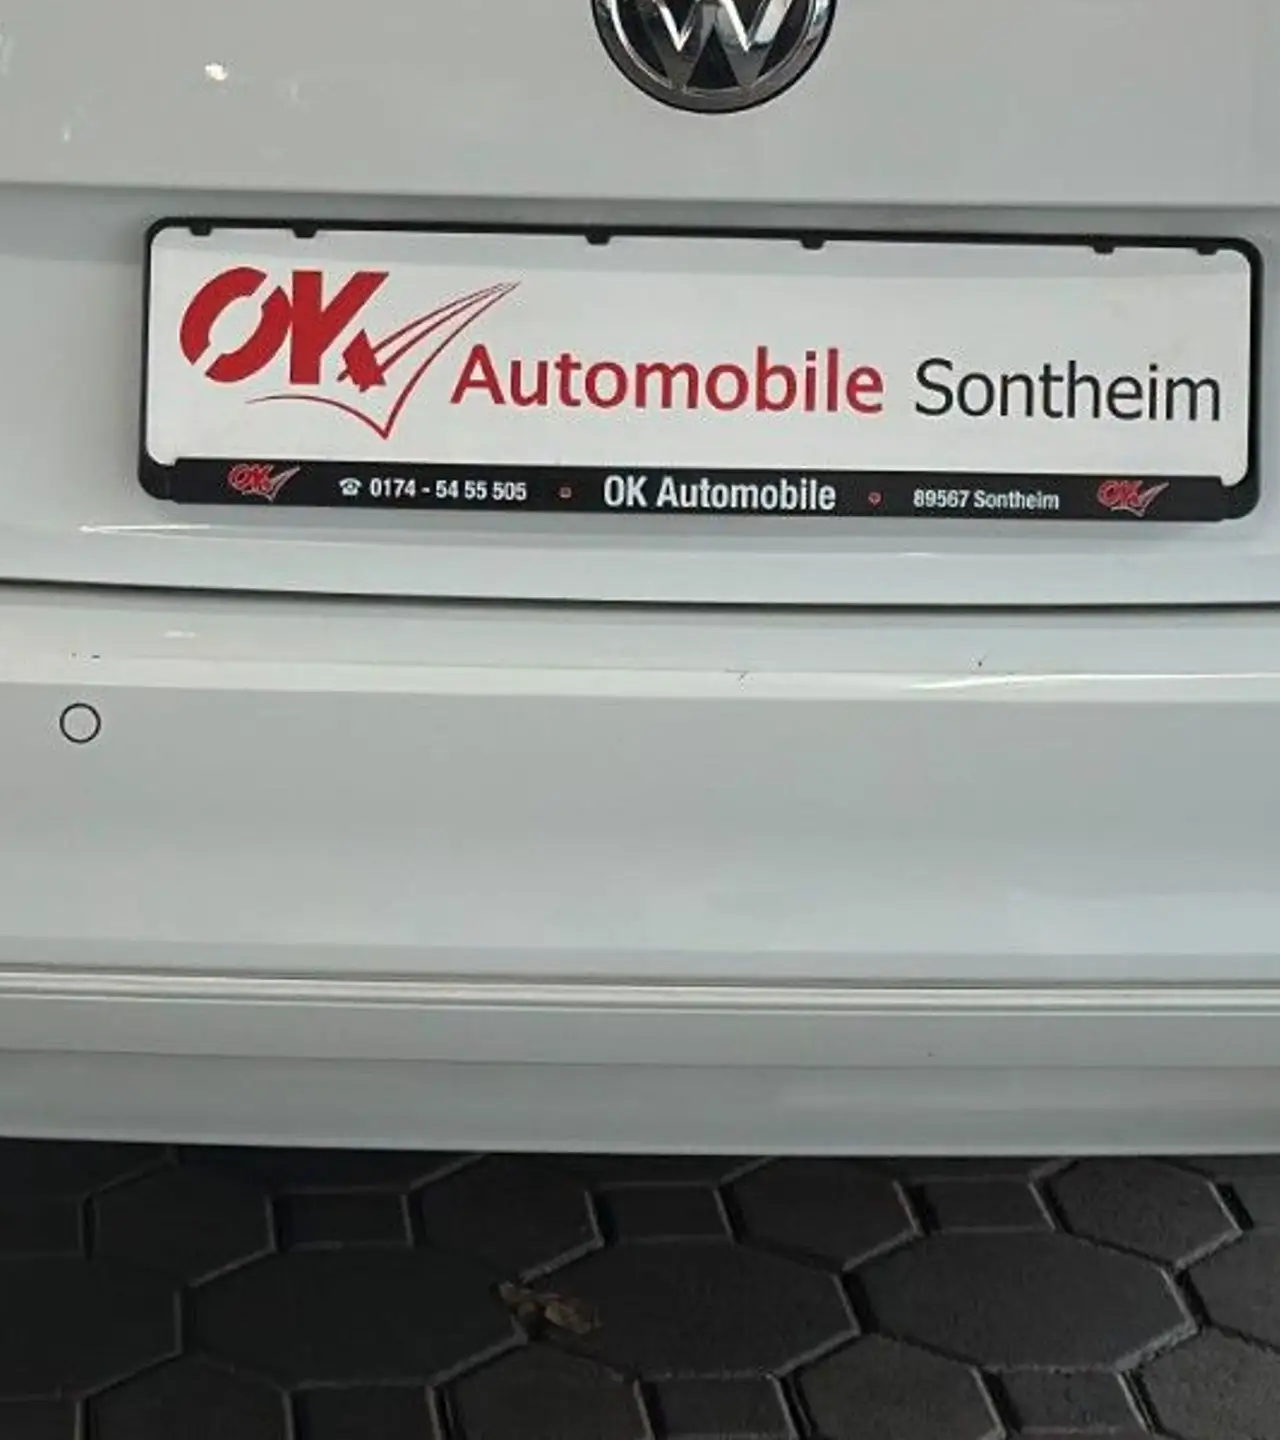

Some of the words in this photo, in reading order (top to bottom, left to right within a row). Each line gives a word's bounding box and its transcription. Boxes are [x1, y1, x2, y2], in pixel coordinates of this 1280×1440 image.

[179, 266, 390, 394] OK
[450, 343, 884, 413] Automobile
[915, 357, 1220, 422] Sontheim
[370, 478, 416, 498] 0174
[435, 479, 458, 499] 54
[464, 479, 487, 499] 55
[492, 480, 527, 501] 505
[604, 475, 648, 507] OK
[656, 475, 837, 511] Automobile
[913, 489, 969, 508] 89567
[974, 490, 1060, 510] Sontheim
